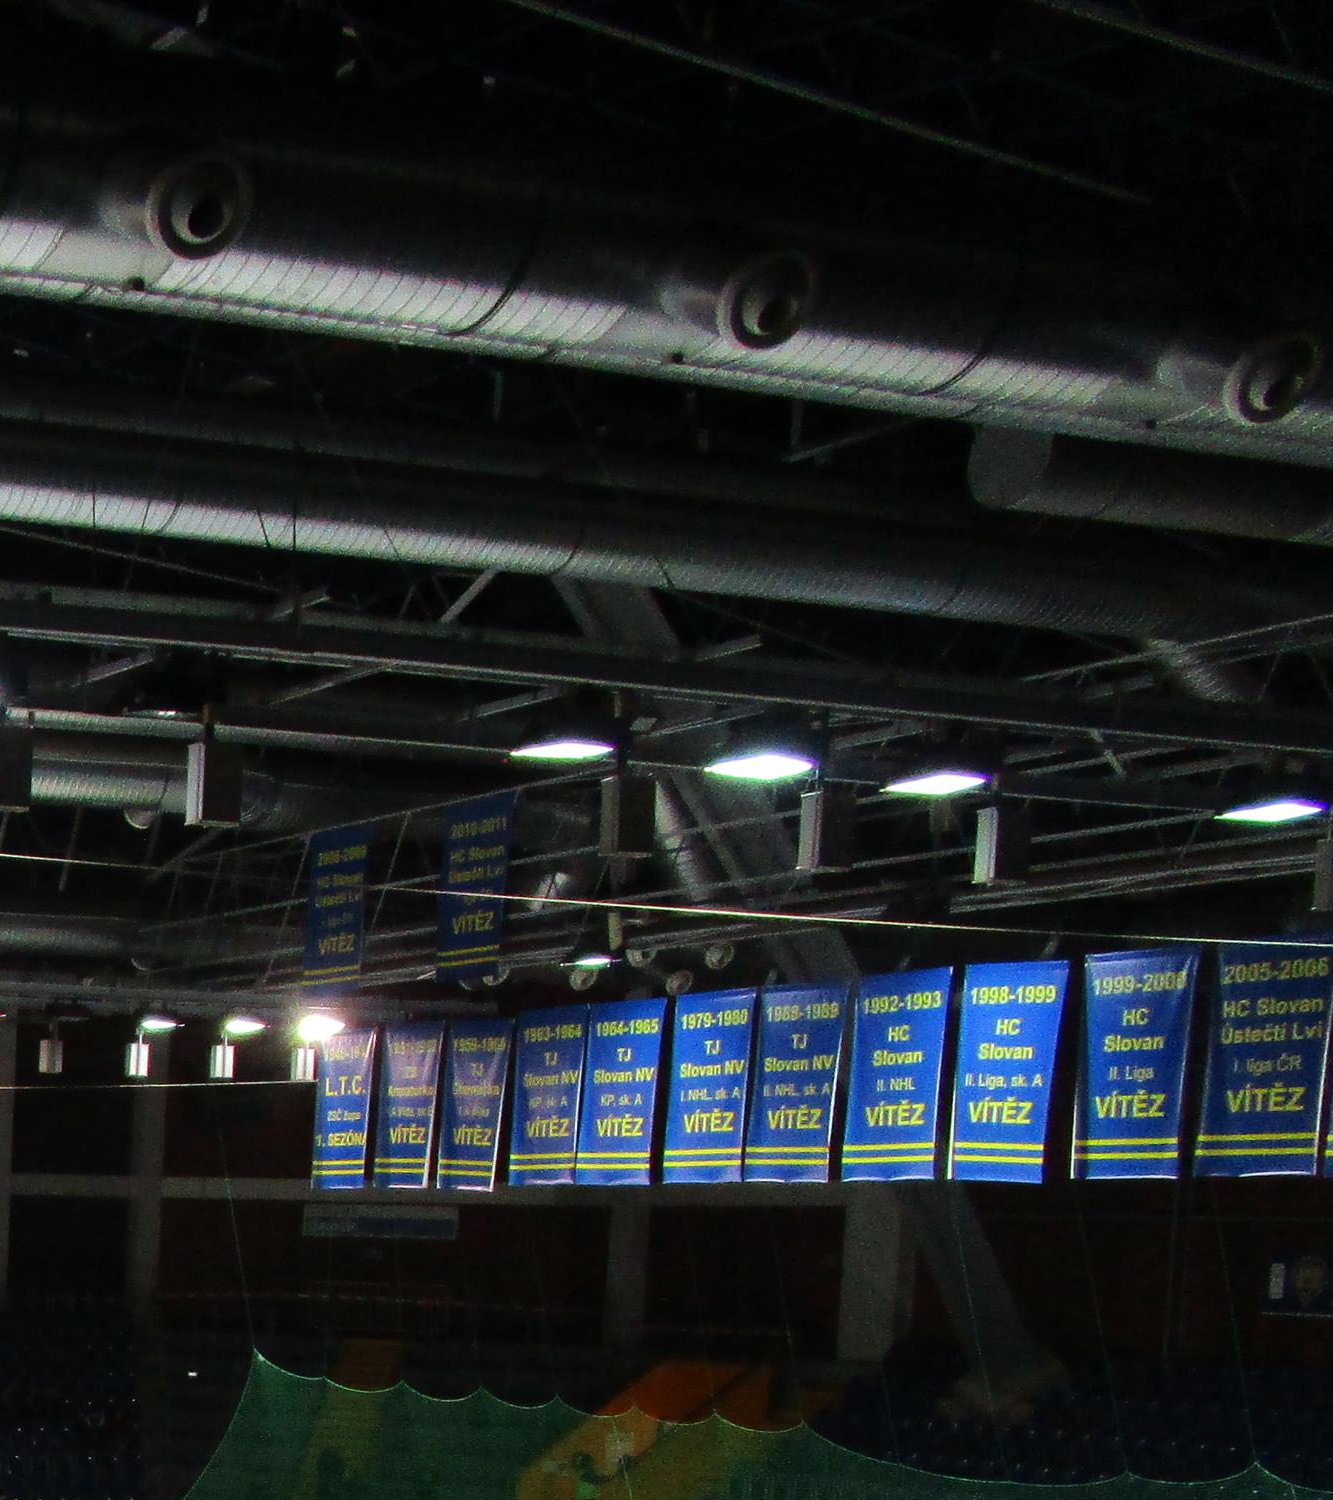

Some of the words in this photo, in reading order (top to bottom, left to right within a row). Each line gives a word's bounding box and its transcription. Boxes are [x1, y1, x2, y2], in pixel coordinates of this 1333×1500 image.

[1221, 957, 1329, 985] 2005-2006
[1093, 970, 1188, 996] 1999-2000
[863, 991, 943, 1015] 1992-1993
[971, 985, 1057, 1005] 1998-1999
[1223, 999, 1251, 1018] HC
[1256, 997, 1323, 1016] Slovan
[681, 1009, 749, 1030] 1979-1980
[1122, 1008, 1150, 1026] HC
[596, 1018, 661, 1037] 1964-1965
[888, 1025, 911, 1042] HC
[996, 1018, 1021, 1036] HC
[1292, 1021, 1323, 1040] Lvi
[704, 1039, 721, 1055] TJ
[791, 1033, 809, 1049] TJ
[1104, 1034, 1165, 1052] Slovan
[544, 1051, 558, 1066] TJ
[616, 1047, 632, 1062] TJ
[873, 1050, 923, 1067] Slovan
[978, 1043, 1035, 1061] Slovan
[680, 1063, 721, 1078] Slovan
[724, 1060, 745, 1076] NV
[764, 1057, 808, 1072] Slovan
[813, 1055, 834, 1070] NV
[523, 1071, 559, 1087] Slovan
[561, 1069, 579, 1084] NV
[593, 1068, 632, 1085] Slovan
[635, 1067, 655, 1082] NV
[1032, 1073, 1043, 1087] A
[1125, 1064, 1155, 1083] Liga
[732, 1086, 742, 1099] A
[889, 1077, 916, 1091] NHL
[634, 1093, 644, 1106] A
[1094, 1089, 1167, 1118] VÍTĚZ
[1226, 1081, 1306, 1113] VÍTĚZ
[767, 1104, 822, 1130] VÍTĚZ
[865, 1099, 926, 1127] VÍTĚZ
[968, 1096, 1033, 1124] VÍTĚZ
[526, 1115, 571, 1138] VÍTĚZ
[596, 1113, 645, 1138] VÍTĚZ
[685, 1107, 736, 1133] VÍTĚZ
